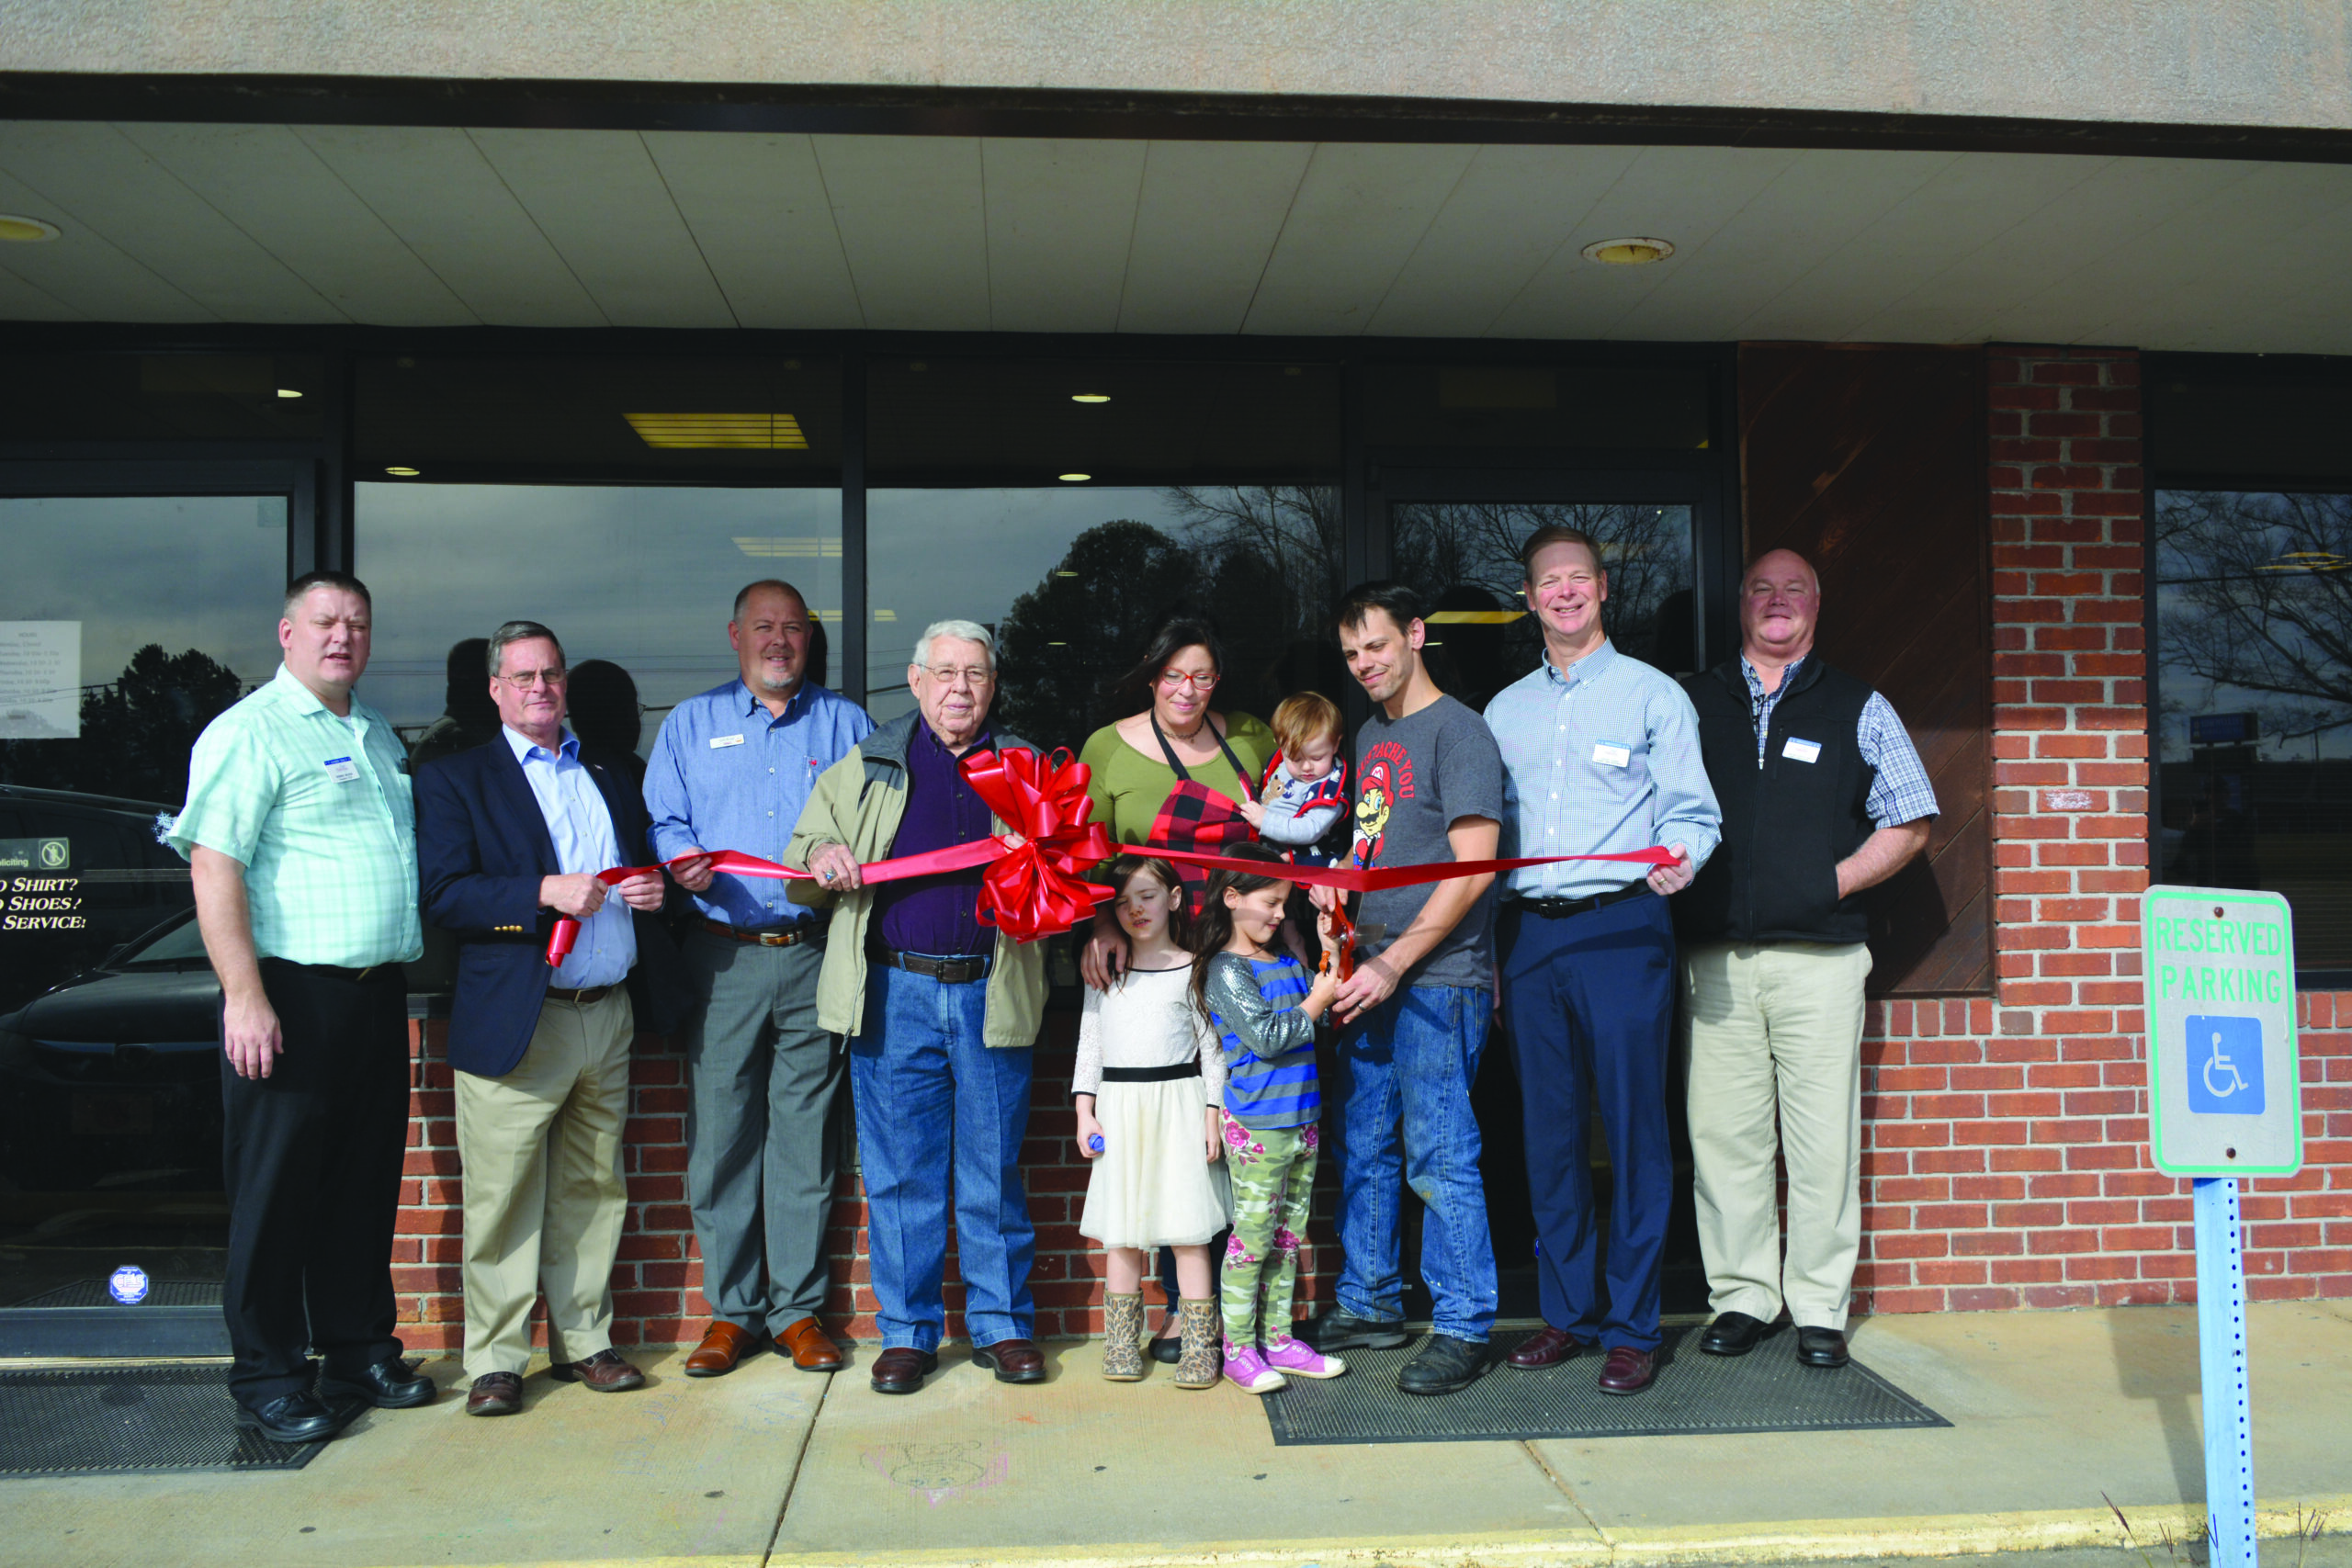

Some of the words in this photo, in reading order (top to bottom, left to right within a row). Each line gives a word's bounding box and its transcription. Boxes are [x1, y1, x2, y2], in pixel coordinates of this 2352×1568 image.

[1397, 757, 1415, 799] YOU
[0, 857, 29, 868] liciting
[11, 876, 79, 893] SHIRT?
[8, 896, 83, 911] SHOES?
[2, 915, 87, 931] SERVICE!
[2155, 916, 2282, 956] RESERVED
[2161, 964, 2282, 1004] PARKING
